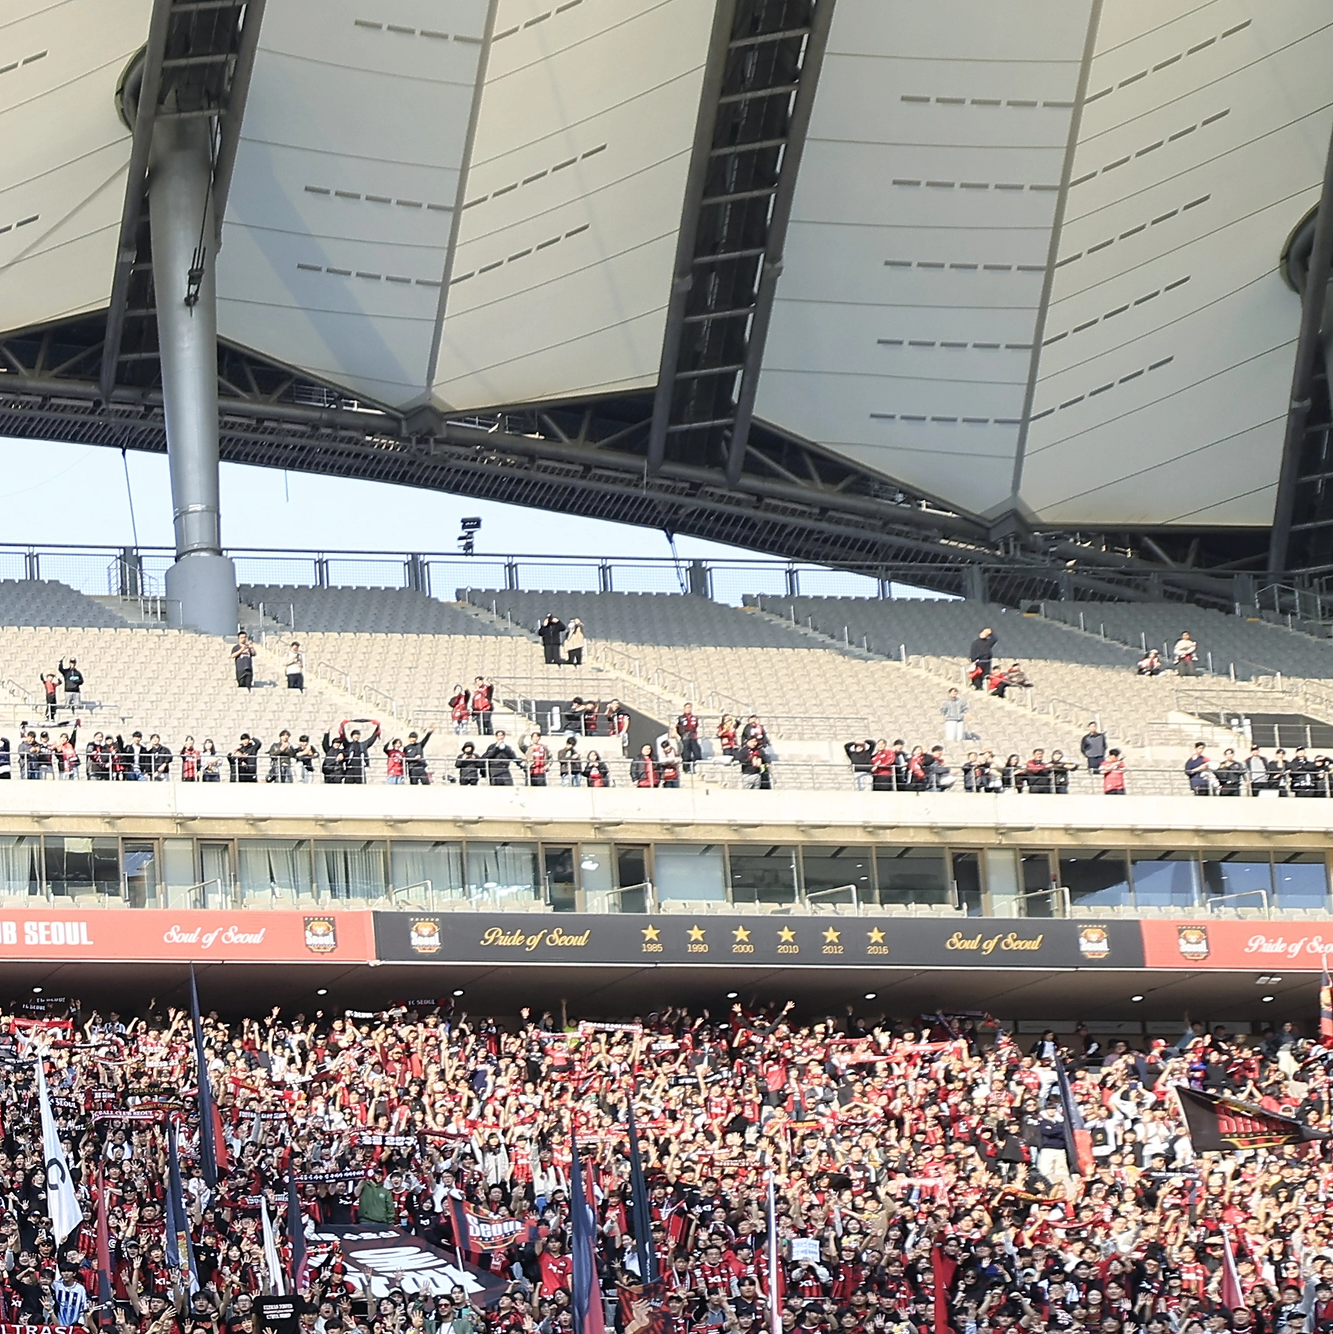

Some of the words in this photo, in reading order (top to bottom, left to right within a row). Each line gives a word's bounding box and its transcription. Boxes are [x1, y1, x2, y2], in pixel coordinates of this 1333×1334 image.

[25, 922, 94, 945] SEOUL
[164, 926, 199, 946] Soul
[200, 928, 221, 949] of
[222, 926, 265, 947] Seoul
[480, 927, 521, 950] Pride
[522, 930, 543, 951] of
[545, 927, 590, 948] Seoul
[946, 931, 979, 951] Soul
[980, 934, 1000, 955] of
[1002, 932, 1043, 952] Seoul
[641, 942, 663, 954] 1985
[686, 942, 708, 954] 1990
[732, 942, 754, 954] 2000
[777, 942, 799, 954] 2010
[822, 942, 844, 954] 2012
[867, 942, 889, 954] 2016
[1244, 934, 1284, 955] Pride
[1285, 937, 1304, 958] of
[467, 1215, 525, 1238] Seoul
